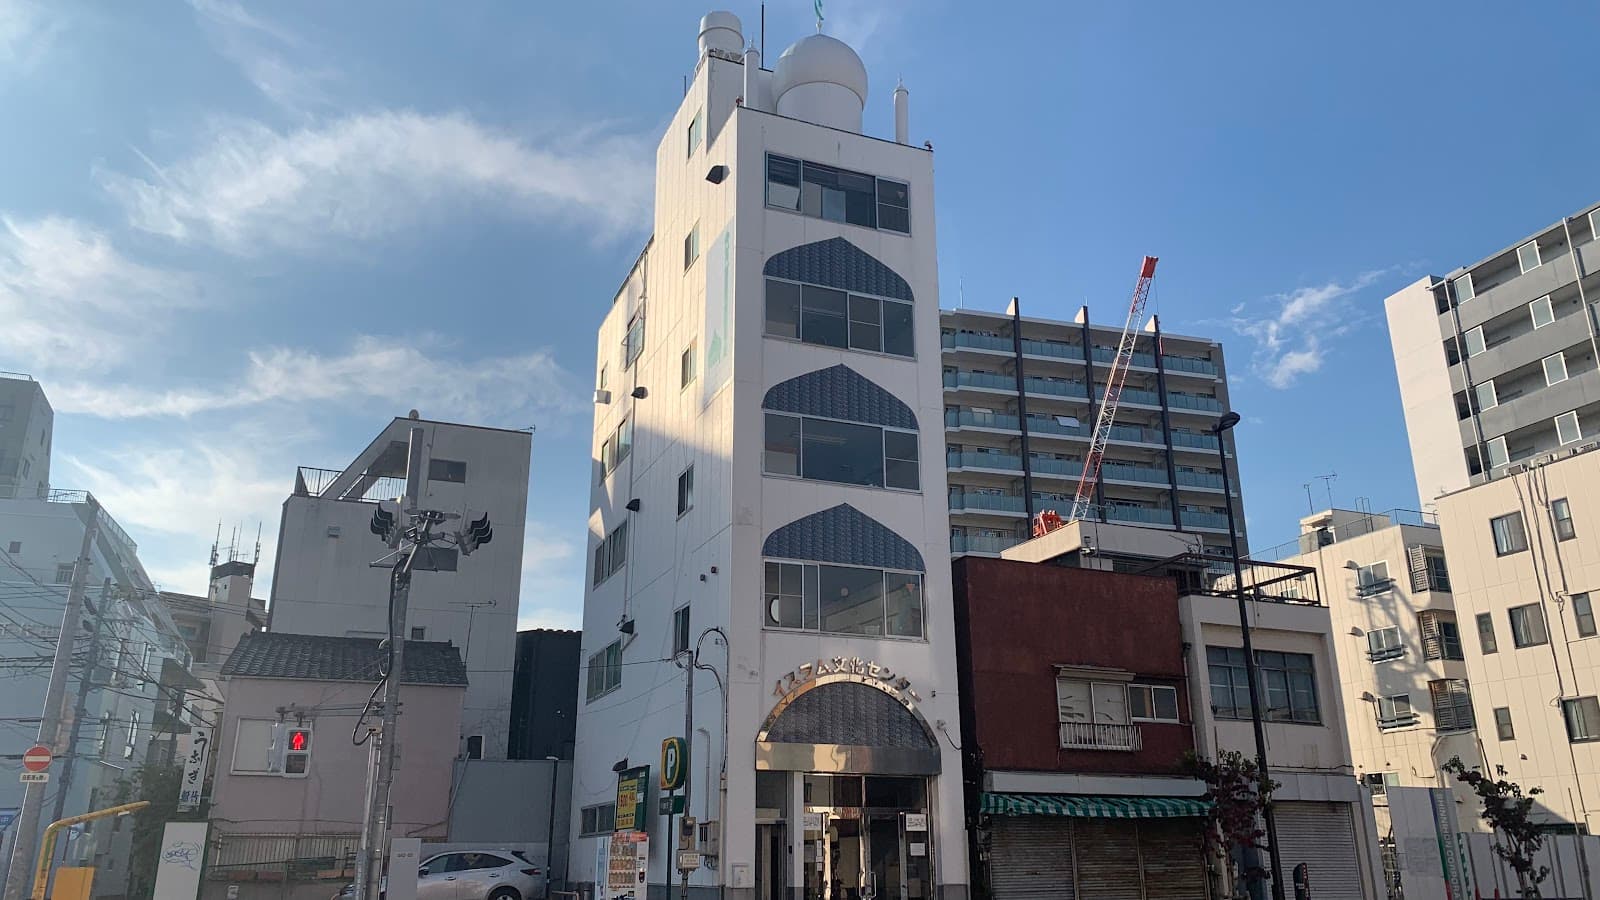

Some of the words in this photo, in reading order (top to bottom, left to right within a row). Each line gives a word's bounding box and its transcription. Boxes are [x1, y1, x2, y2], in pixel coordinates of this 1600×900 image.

[773, 655, 922, 704] イスラム文化センター
[667, 748, 676, 779] P
